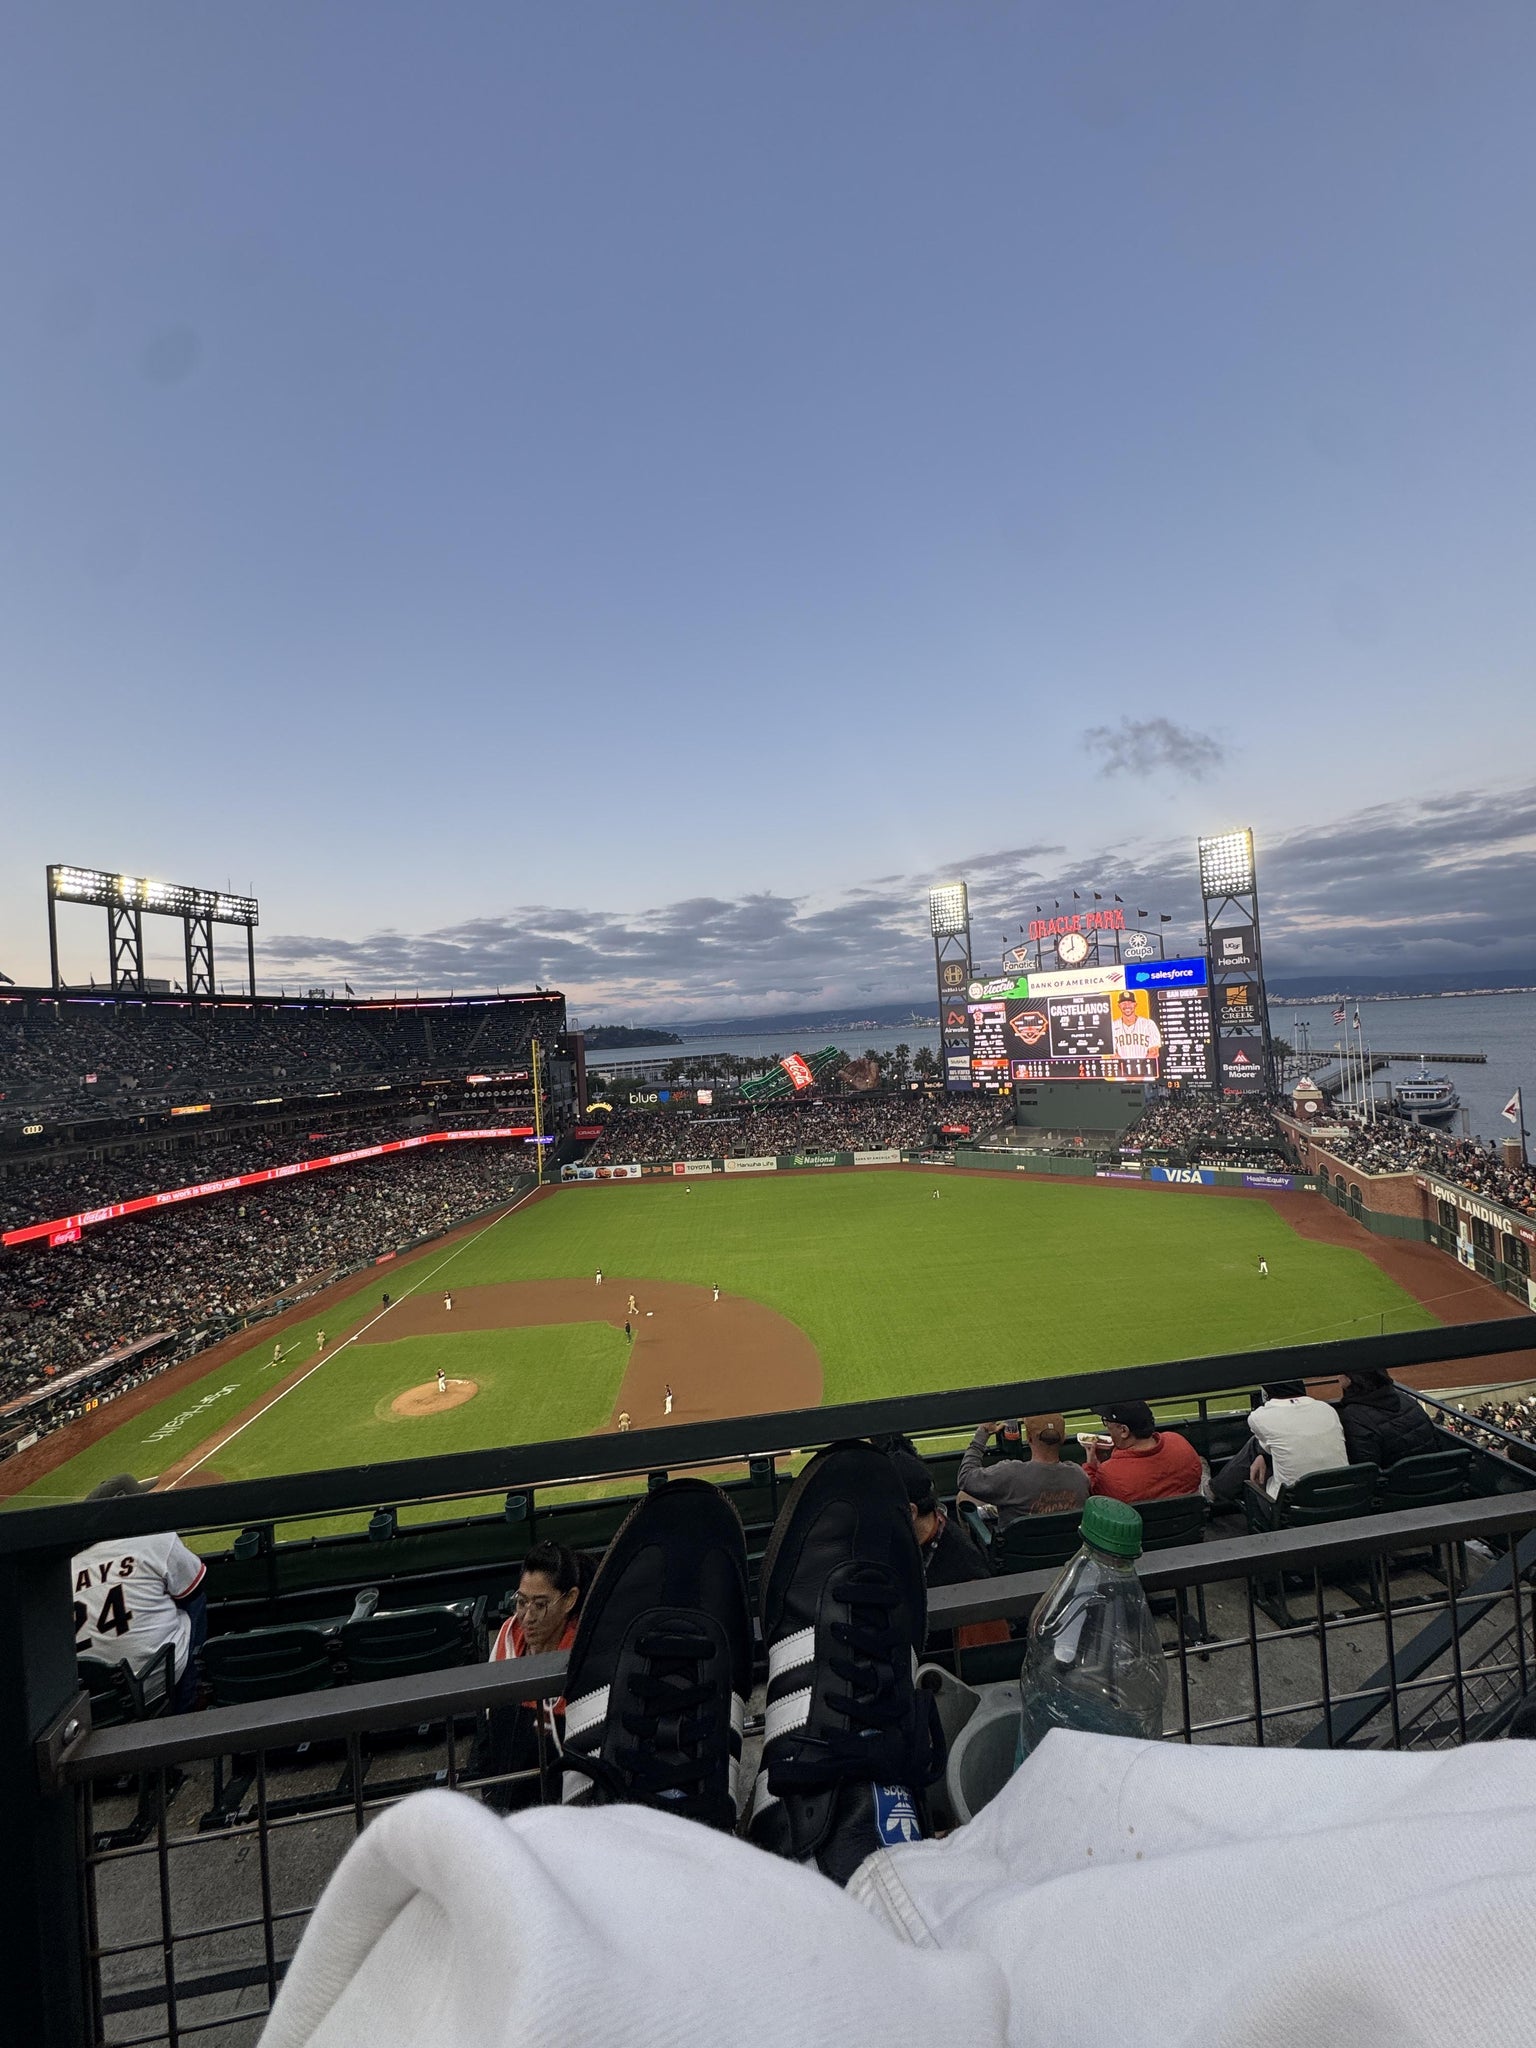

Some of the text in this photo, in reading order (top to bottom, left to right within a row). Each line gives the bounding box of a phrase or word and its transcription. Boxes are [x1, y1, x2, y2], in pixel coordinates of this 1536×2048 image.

[1029, 909, 1126, 940] ORACLE PARK
[1126, 948, 1152, 957] coupa
[1004, 960, 1036, 970] Fanatics
[1218, 956, 1250, 966] Health
[1151, 969, 1194, 980] salesforce
[1066, 978, 1104, 986] AMERICA
[1051, 1002, 1109, 1016] CASTELLANOS
[629, 1092, 658, 1104] blue
[804, 1155, 836, 1164] National
[1162, 1169, 1203, 1184] VISA
[1246, 1175, 1289, 1184] HealthEquity
[157, 1194, 171, 1202] Fan
[172, 1190, 192, 1199] work
[200, 1183, 223, 1192] thirsty
[224, 1178, 241, 1186] work
[1459, 1196, 1512, 1234] LANDING
[141, 1404, 213, 1443] Health
[76, 1556, 135, 1592] AYS
[74, 1584, 133, 1652] 24
